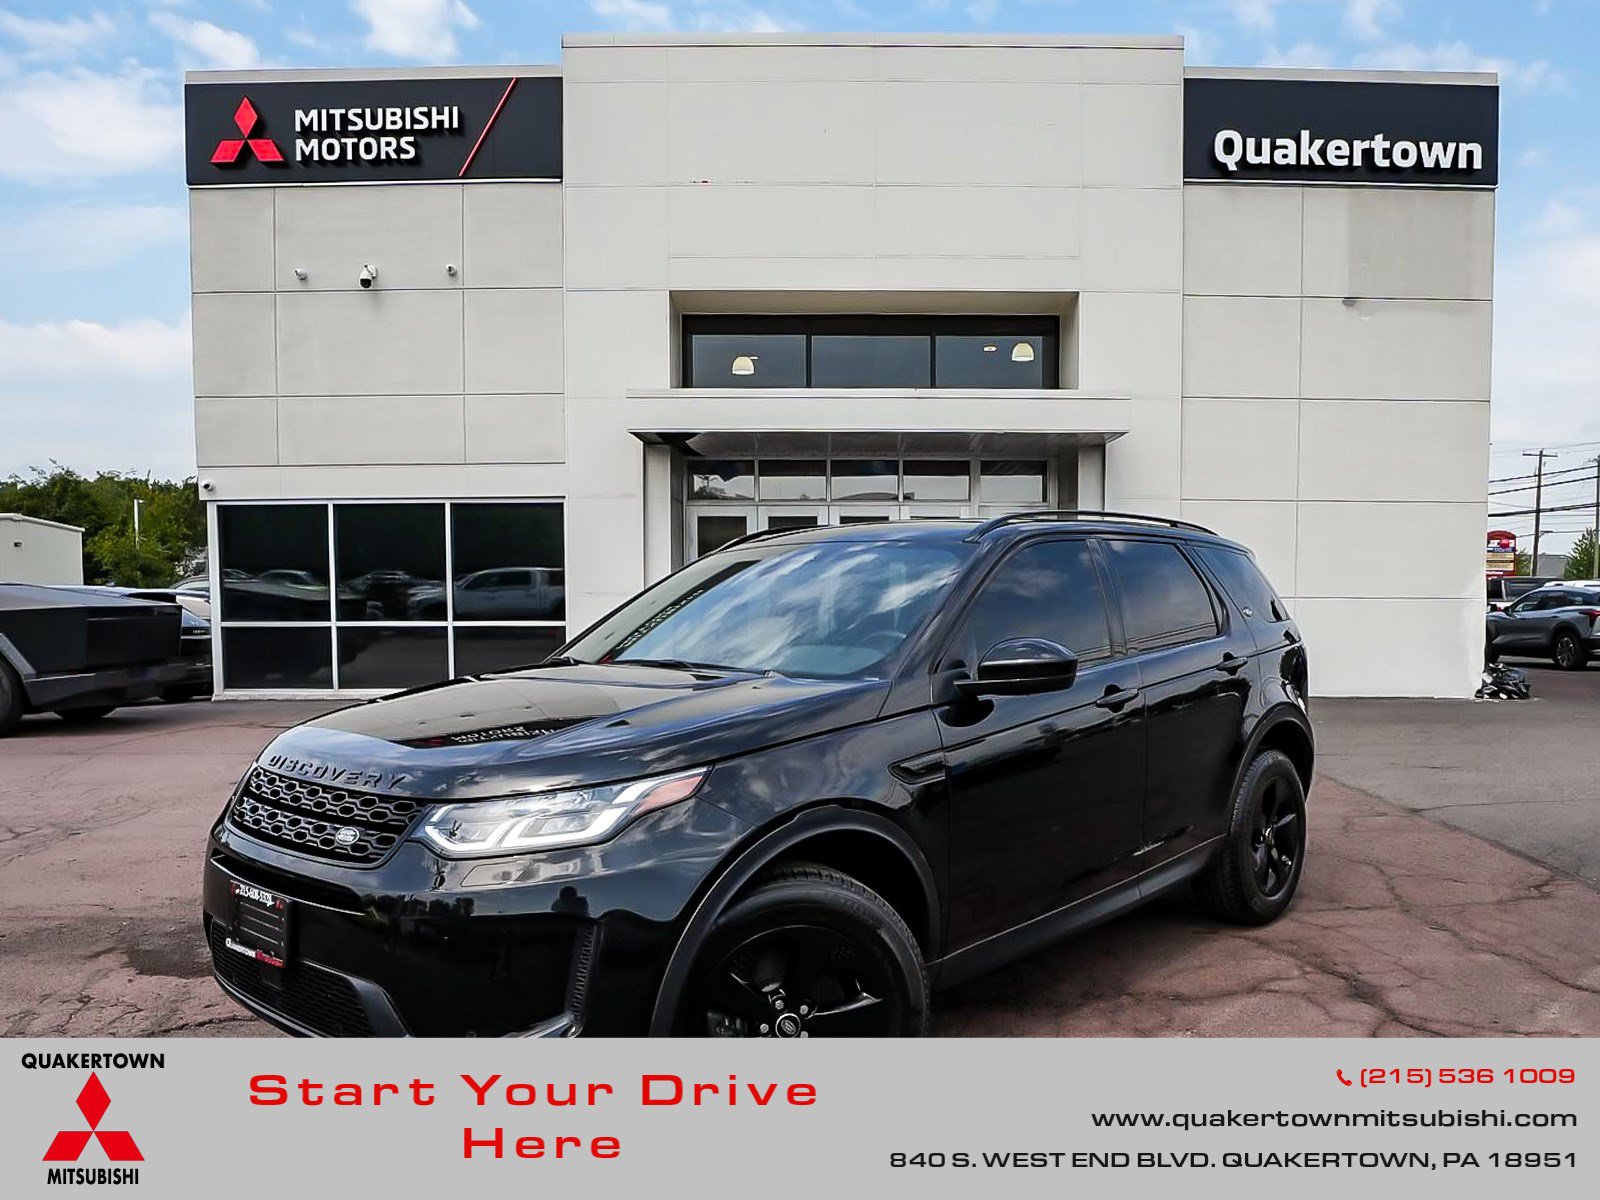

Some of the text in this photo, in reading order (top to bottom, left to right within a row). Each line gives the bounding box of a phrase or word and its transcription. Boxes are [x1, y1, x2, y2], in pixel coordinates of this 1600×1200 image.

[294, 105, 459, 132] MITSUBISHI
[295, 136, 416, 162] MOTORS
[1214, 129, 1483, 171] Quakertown
[268, 755, 406, 790] DISCOVERY
